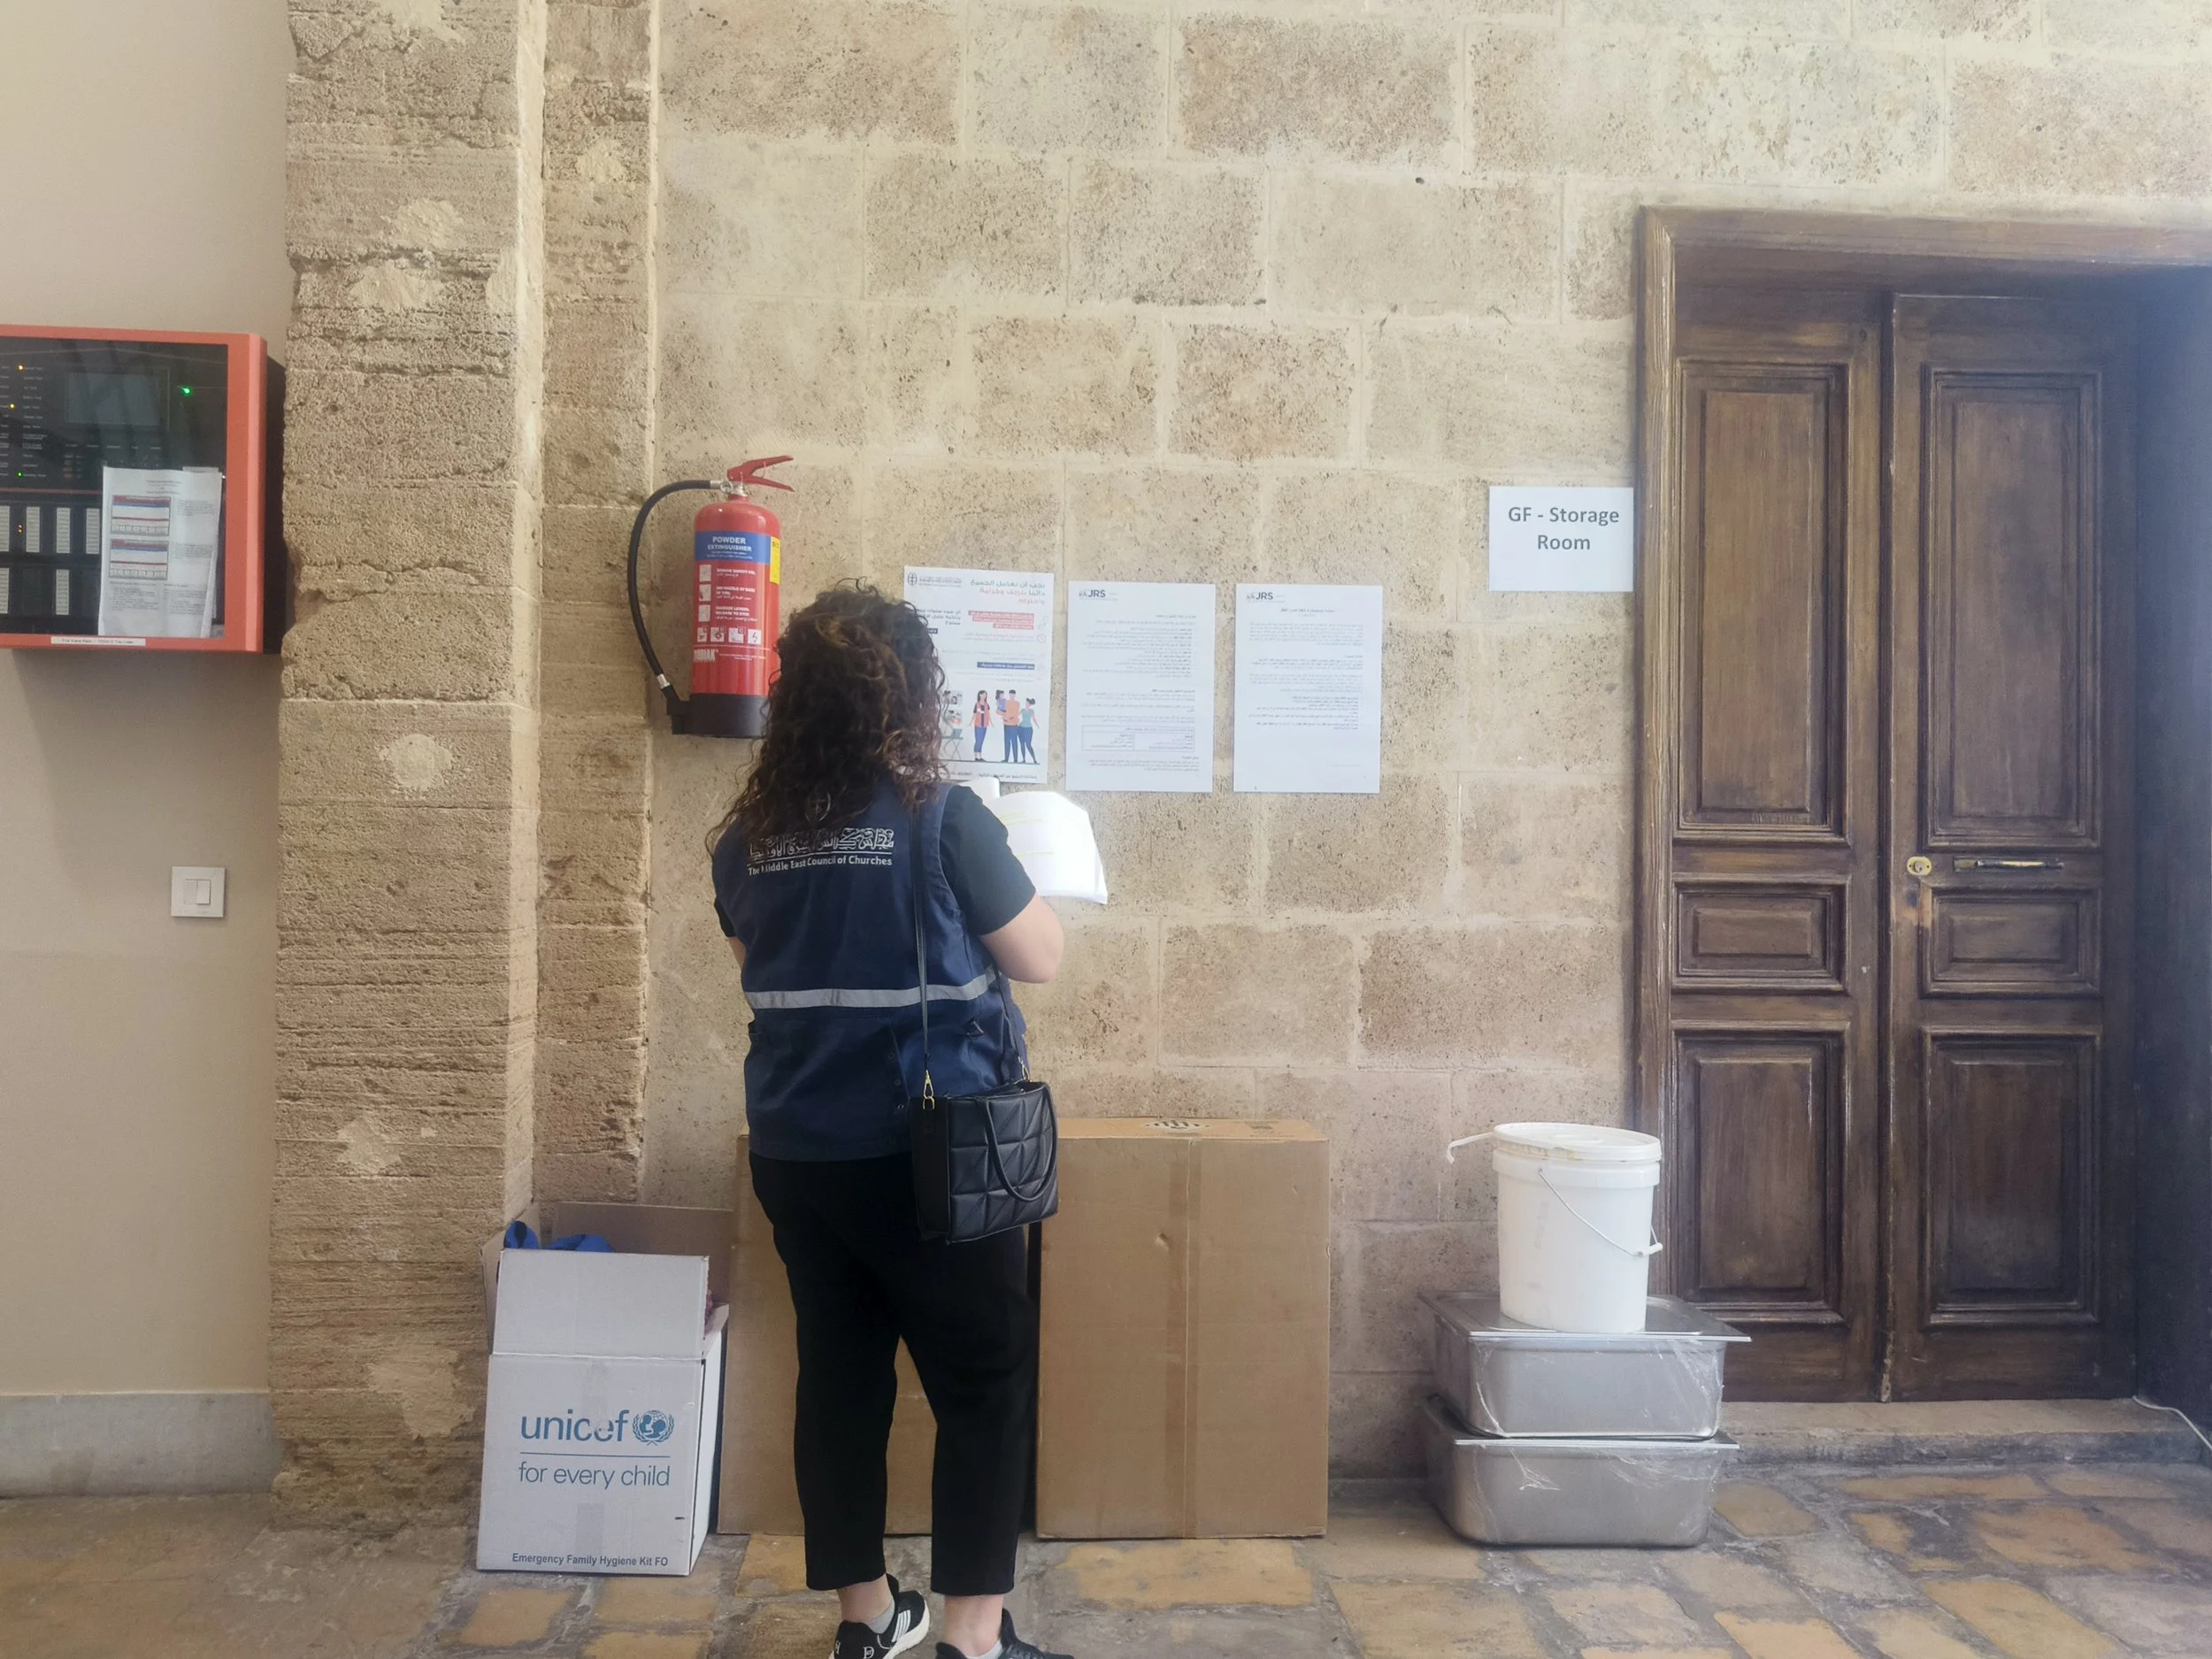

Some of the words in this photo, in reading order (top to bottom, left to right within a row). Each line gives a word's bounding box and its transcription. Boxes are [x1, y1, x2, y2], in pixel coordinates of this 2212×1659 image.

[1509, 507, 1532, 522] GF
[1549, 507, 1619, 526] Storage
[1537, 534, 1590, 549] Room
[1087, 589, 1106, 598] JRS
[1256, 592, 1274, 601] JRS
[807, 856, 836, 866] Council
[837, 855, 847, 864] of
[849, 855, 892, 866] Churches
[521, 1409, 630, 1442] unicef
[518, 1461, 548, 1483] for
[553, 1468, 615, 1490] every
[620, 1464, 671, 1486] child
[512, 1553, 564, 1566] Emergency
[566, 1555, 596, 1567] Family
[599, 1555, 637, 1567] Hygiene
[639, 1556, 652, 1566] Kit
[655, 1557, 669, 1566] FO
